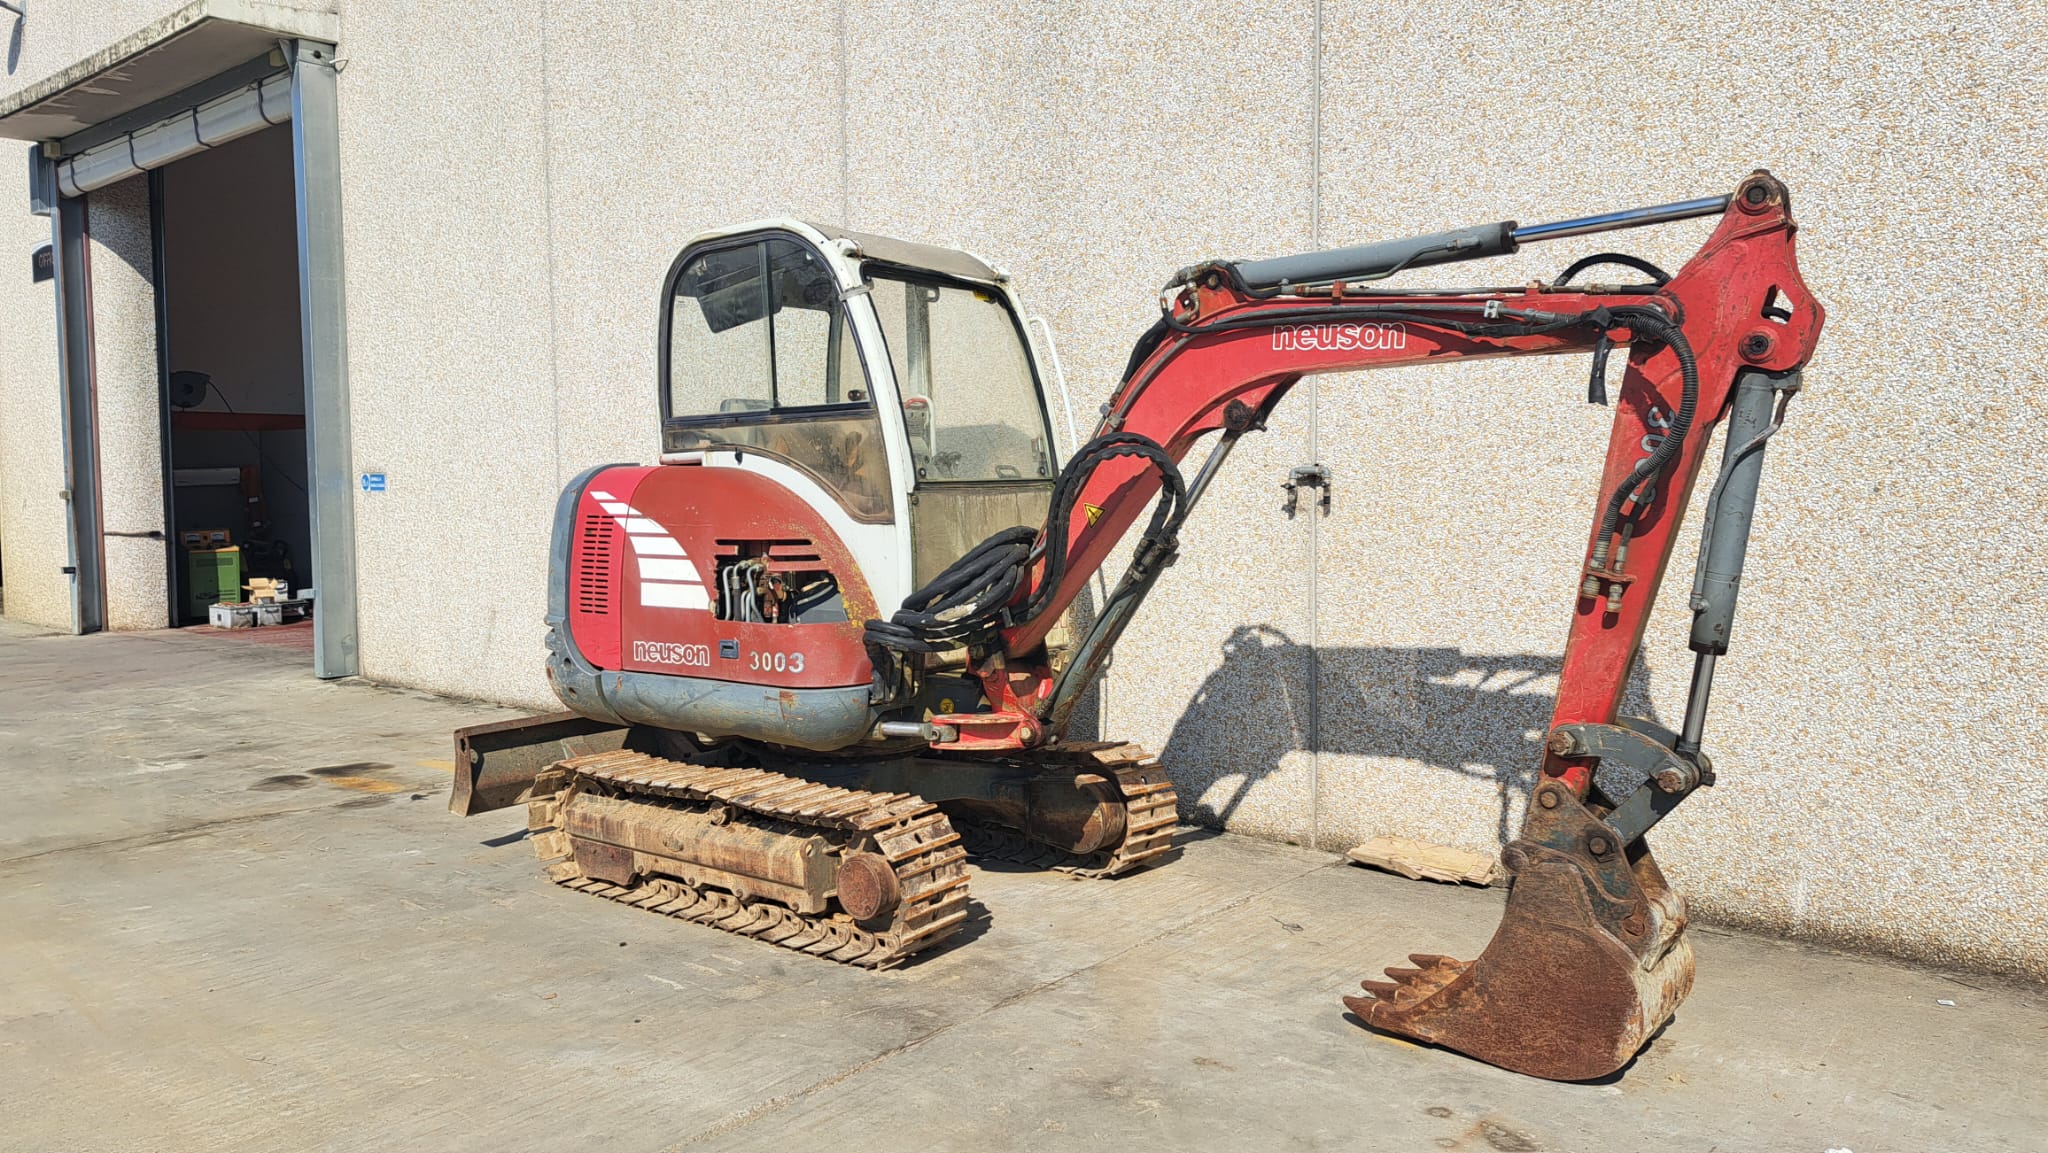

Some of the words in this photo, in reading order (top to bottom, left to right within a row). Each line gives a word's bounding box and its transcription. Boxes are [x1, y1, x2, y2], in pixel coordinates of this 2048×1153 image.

[1272, 322, 1406, 351] neuson
[1628, 406, 1676, 503] 30
[633, 640, 711, 667] neuson
[750, 651, 805, 673] 3003
